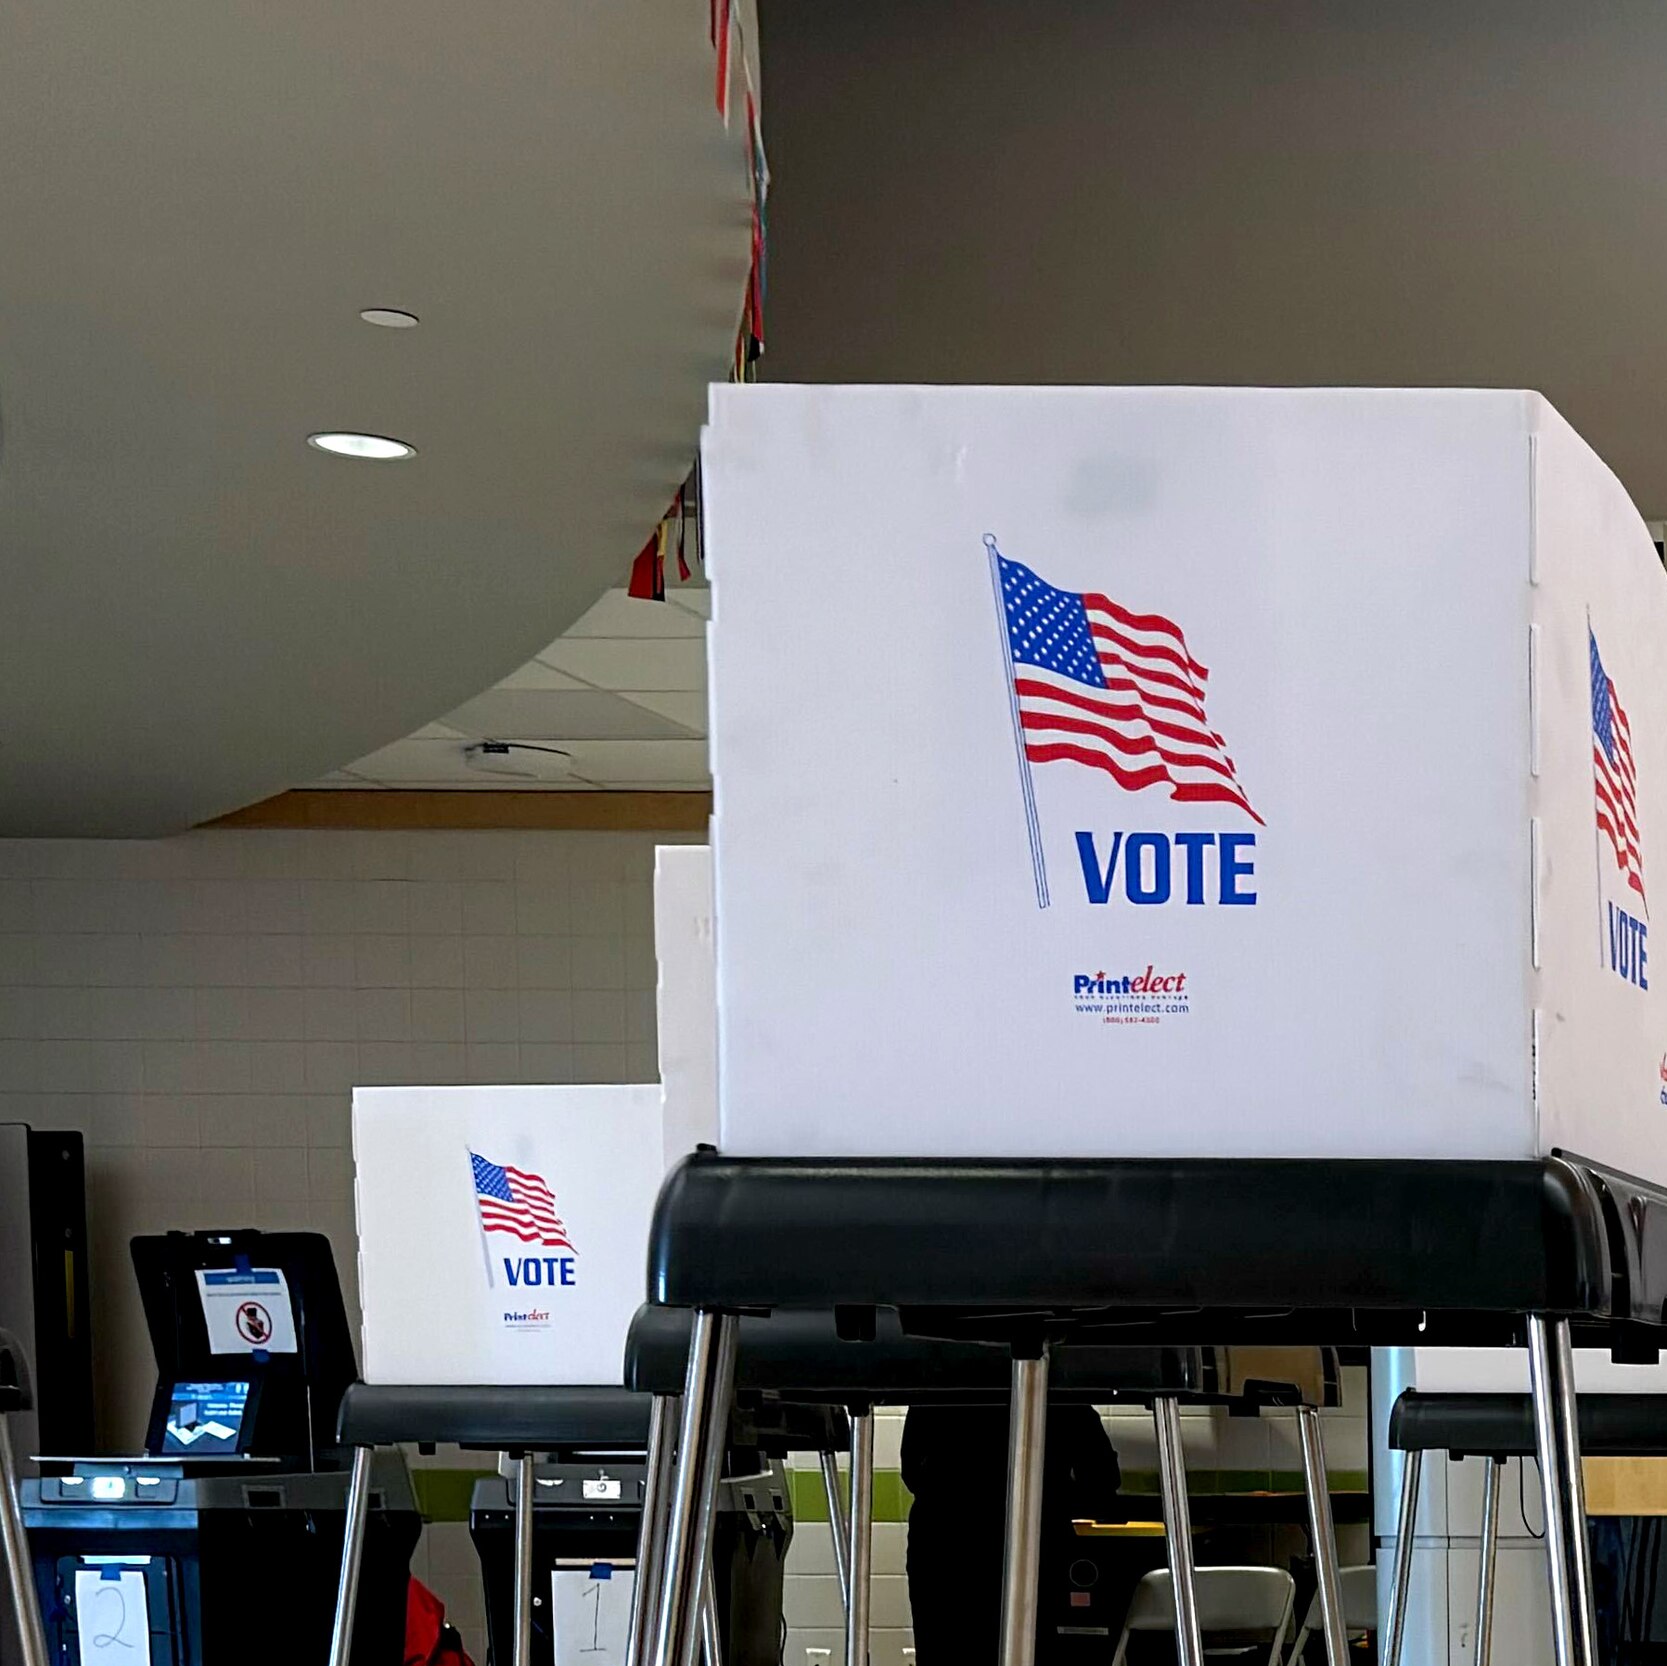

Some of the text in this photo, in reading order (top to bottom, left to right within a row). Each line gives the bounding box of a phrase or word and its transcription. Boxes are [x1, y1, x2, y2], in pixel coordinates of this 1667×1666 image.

[1075, 831, 1258, 905] VOTE
[1608, 900, 1649, 991] VOTE
[1073, 964, 1187, 995] Printelect
[1075, 1002, 1190, 1015] www.printelect.com
[503, 1257, 577, 1287] VOTE
[93, 1586, 135, 1648] 2
[580, 1582, 607, 1652] 1
